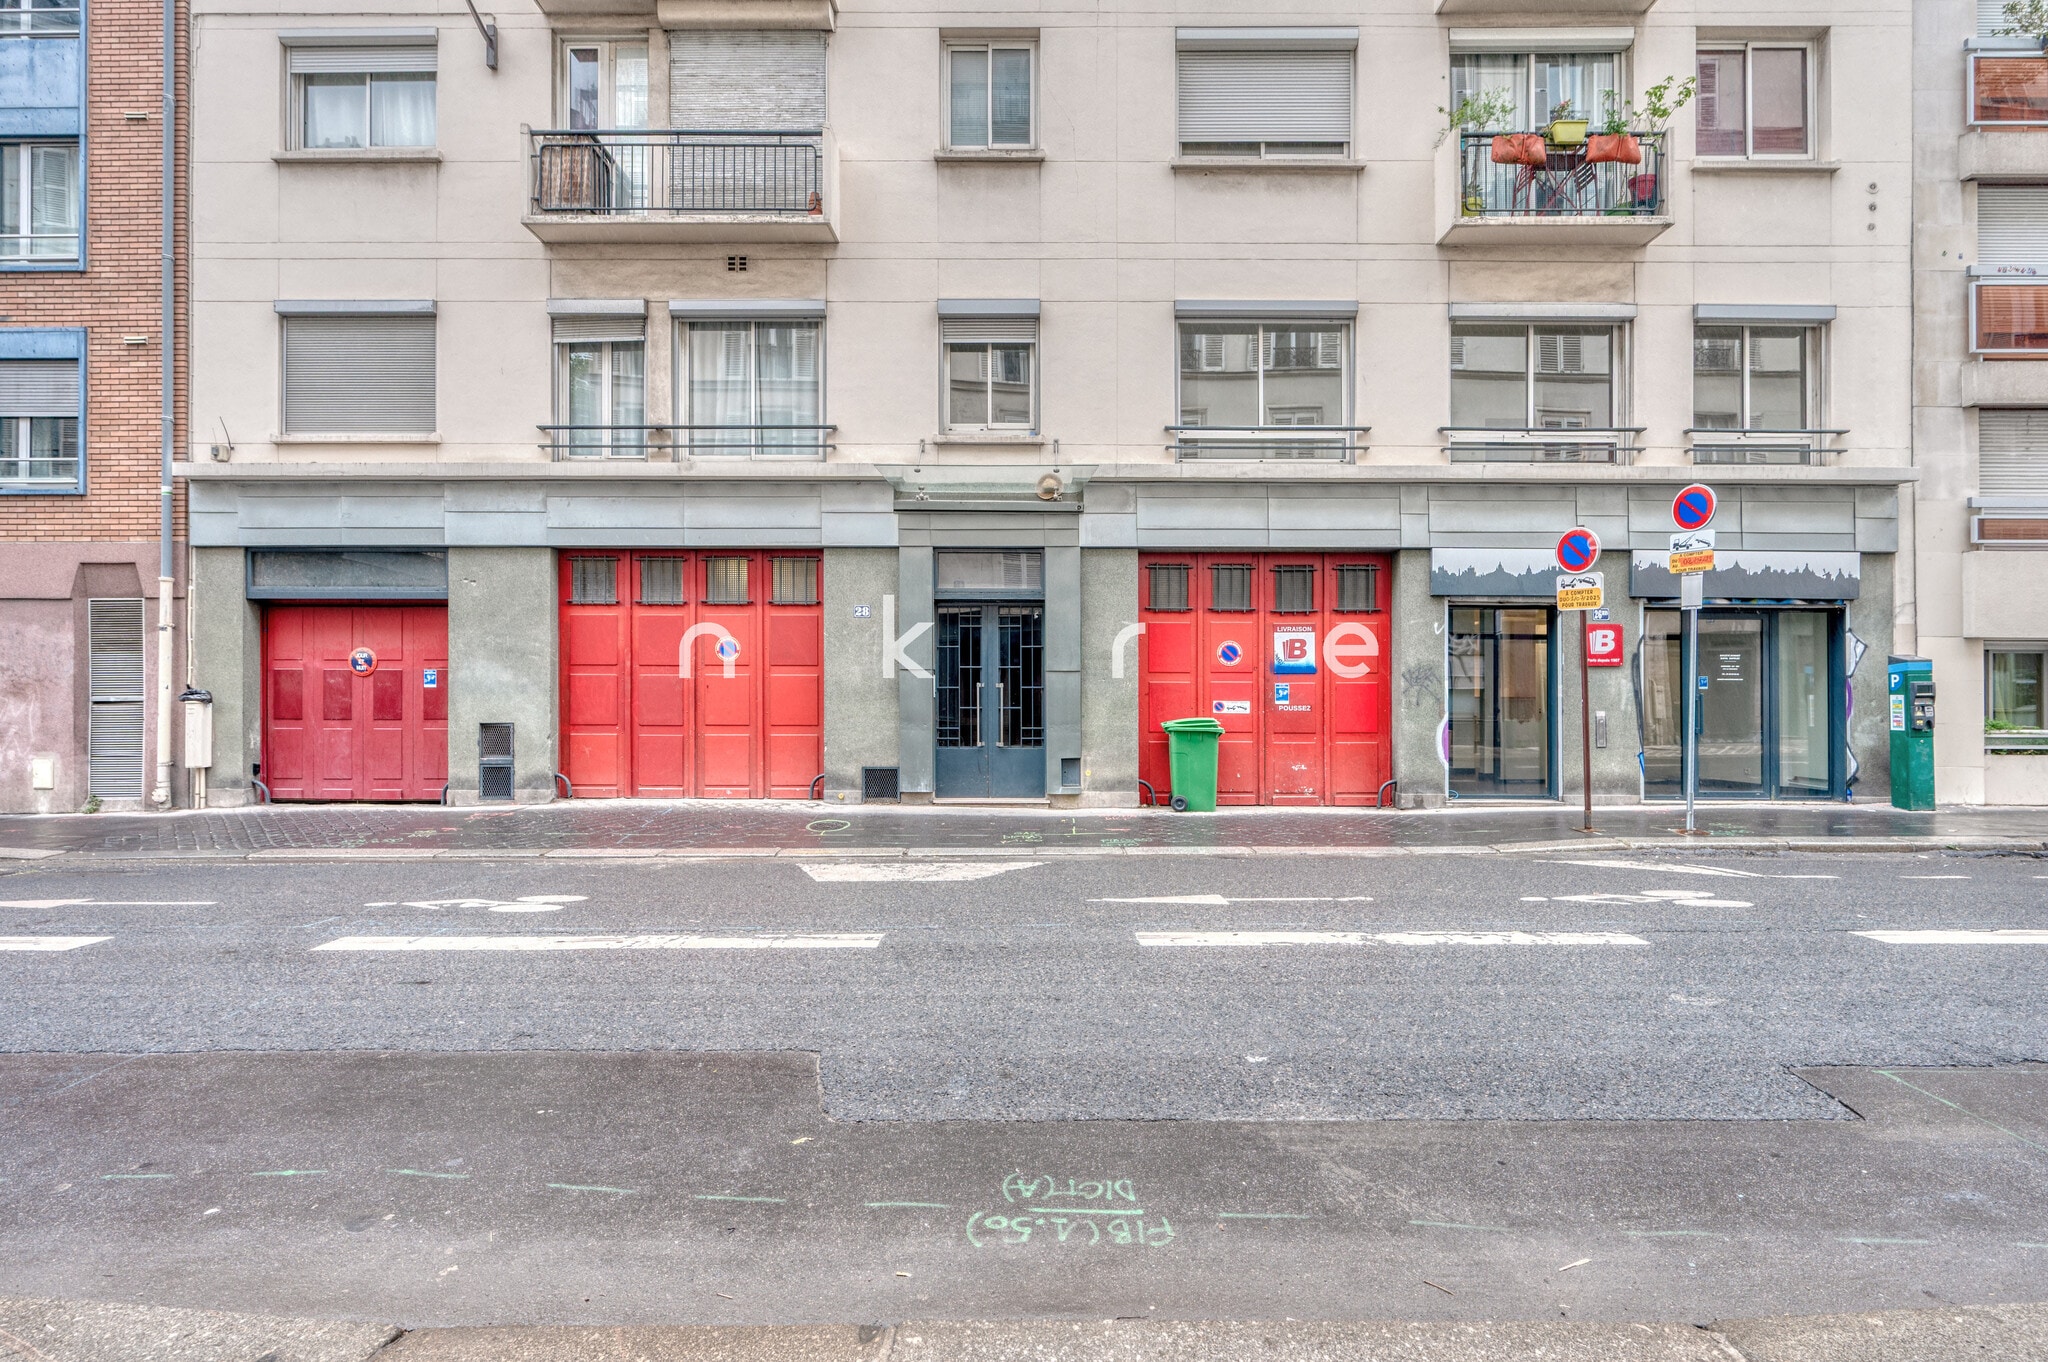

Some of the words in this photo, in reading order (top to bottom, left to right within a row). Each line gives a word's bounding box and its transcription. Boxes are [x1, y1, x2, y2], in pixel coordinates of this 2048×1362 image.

[855, 606, 869, 617] 28
[1285, 638, 1307, 660] B
[1590, 630, 1615, 654] B
[1890, 674, 1900, 687] P
